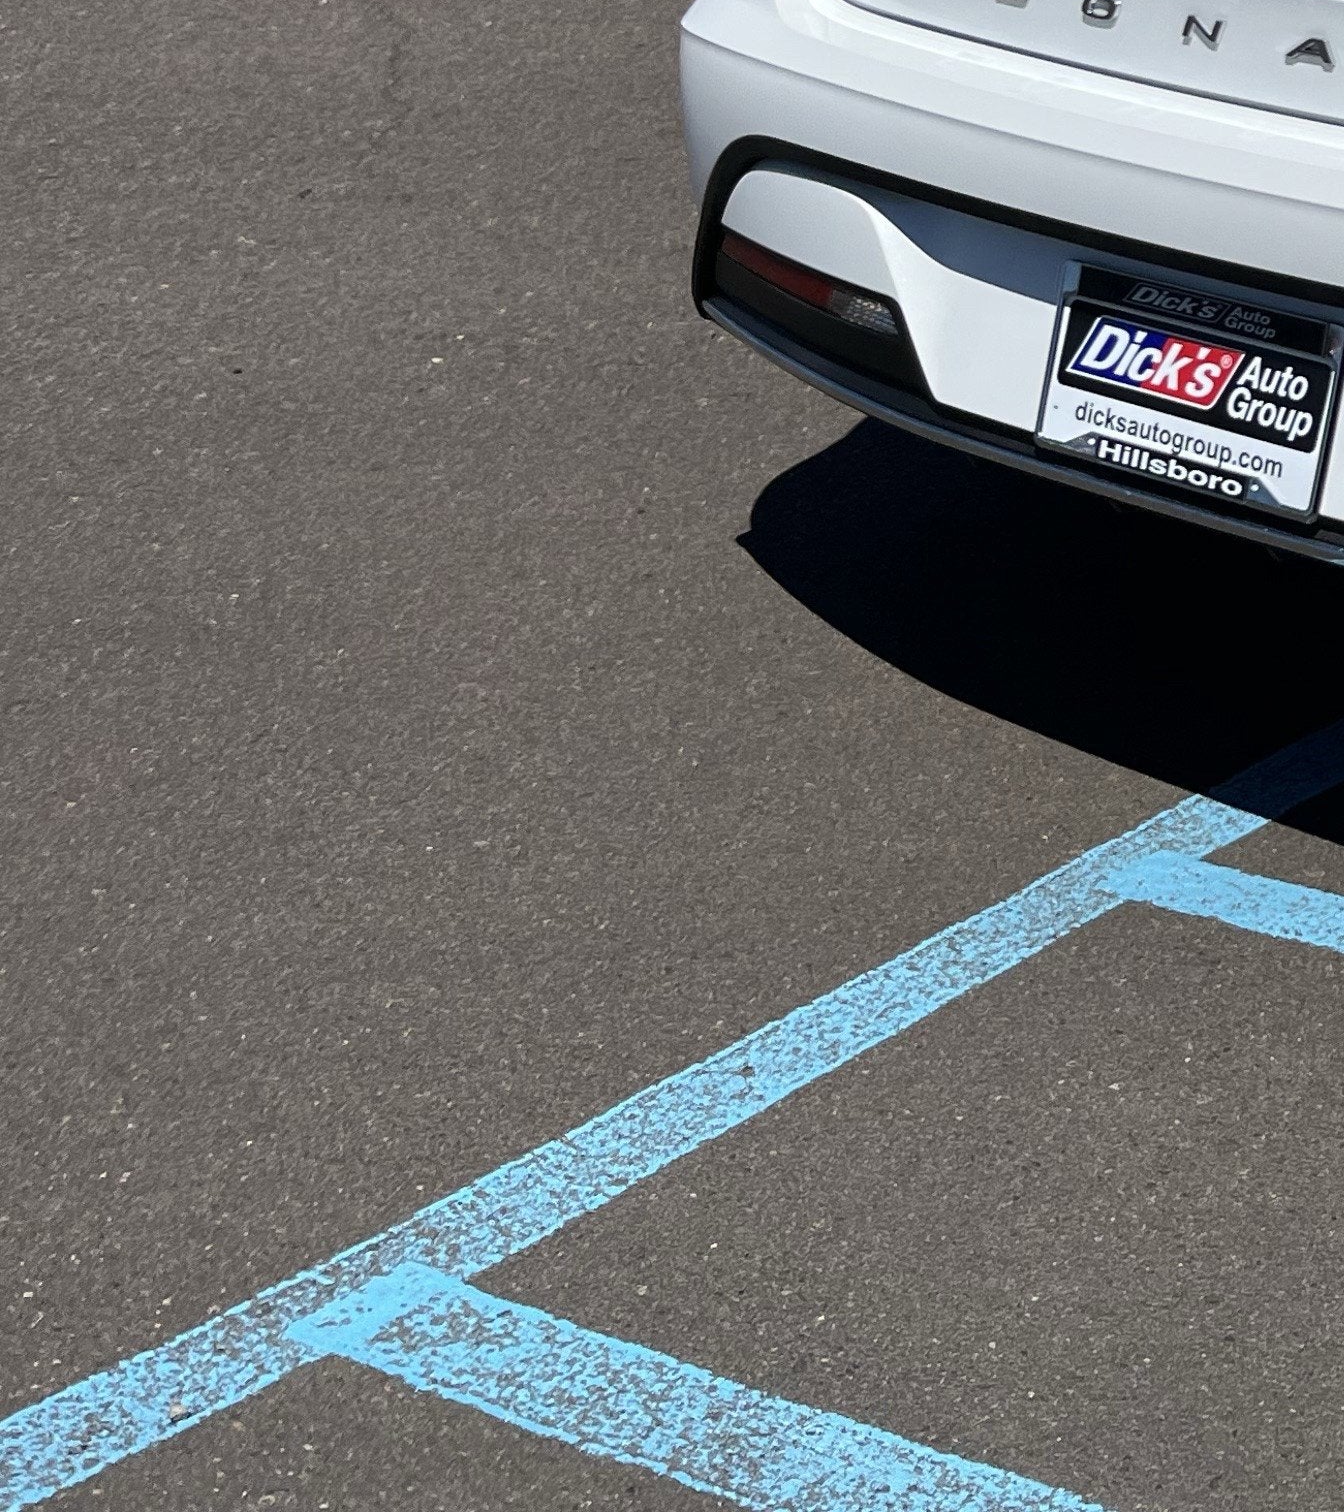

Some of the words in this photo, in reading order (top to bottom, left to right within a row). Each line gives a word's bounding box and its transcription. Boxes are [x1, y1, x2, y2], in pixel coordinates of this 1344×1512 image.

[1131, 286, 1219, 320] Dick's
[1230, 306, 1271, 326] Auto
[1224, 317, 1276, 339] Group
[1081, 324, 1222, 399] Dick's
[1237, 357, 1310, 401] Auto
[1075, 401, 1284, 479] dicksautogroup.com
[1226, 388, 1313, 441] Group
[1098, 438, 1244, 497] Hillsboro
